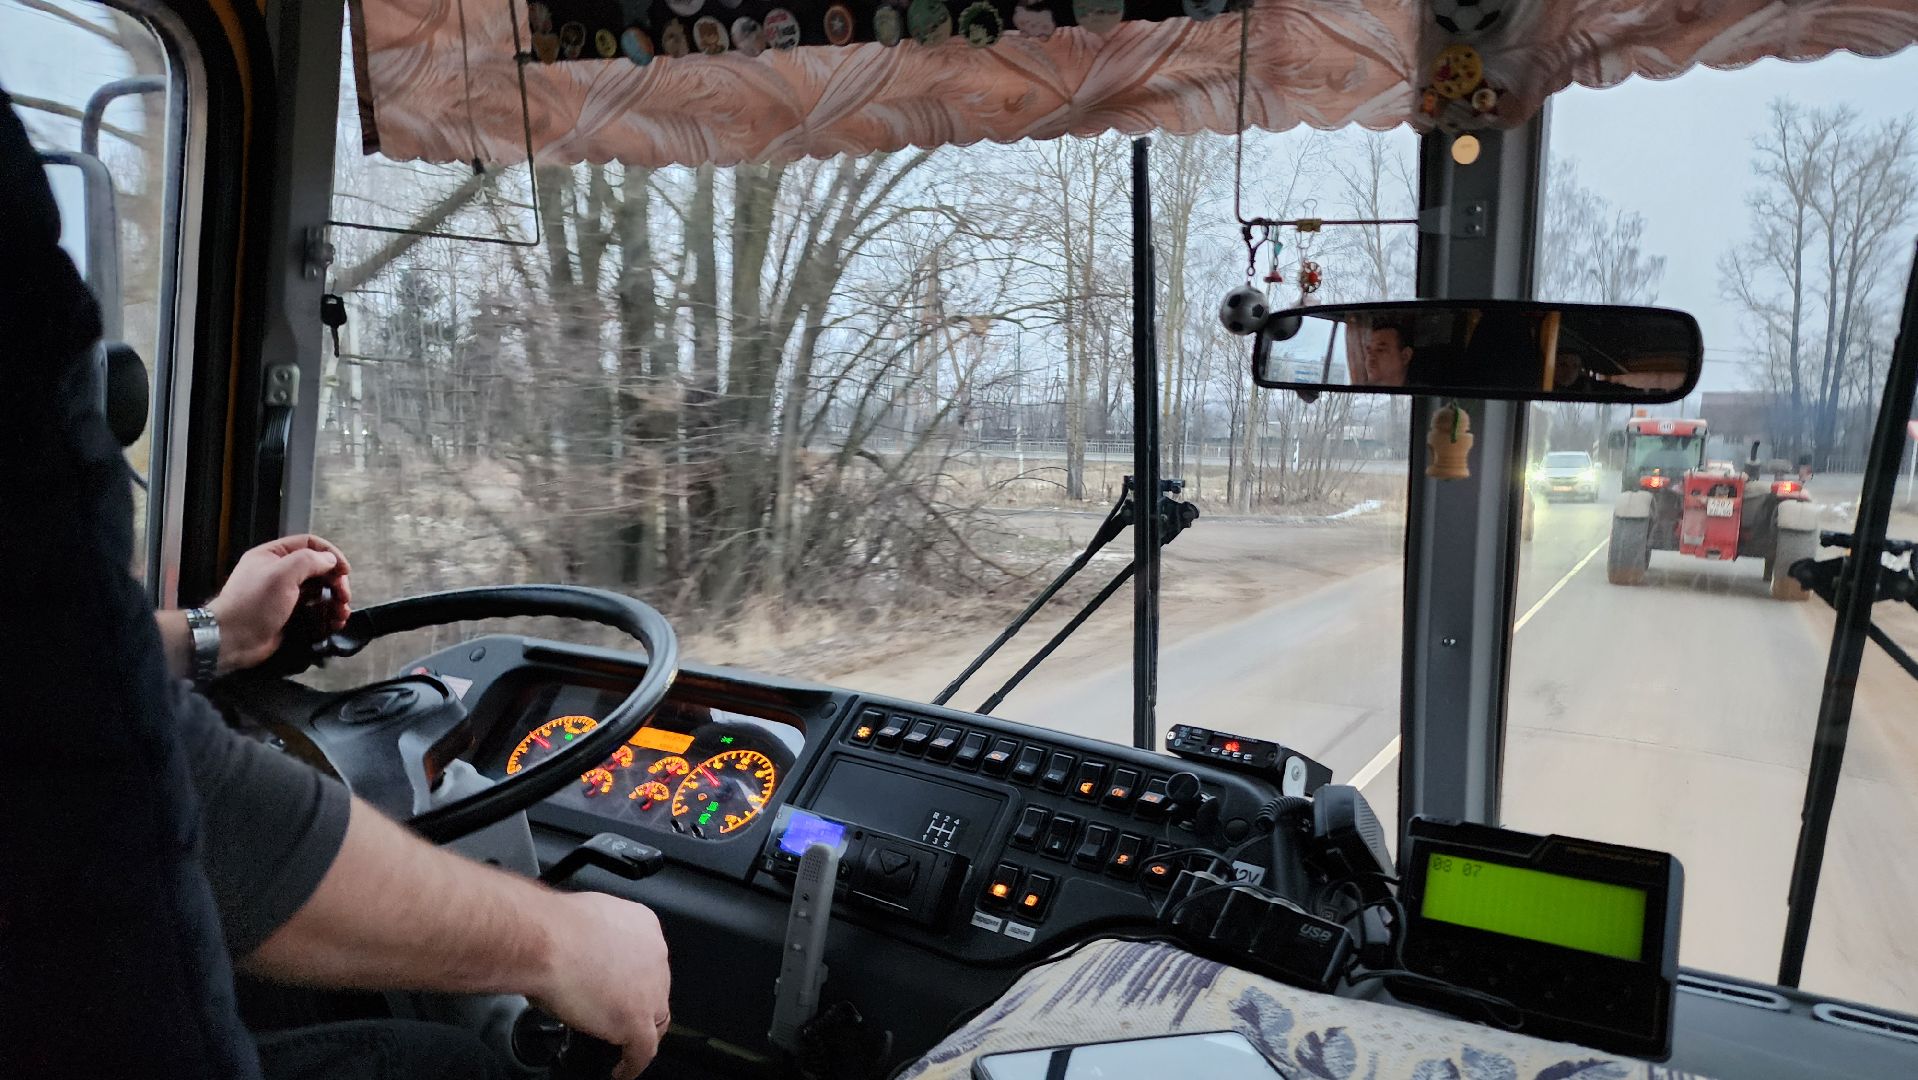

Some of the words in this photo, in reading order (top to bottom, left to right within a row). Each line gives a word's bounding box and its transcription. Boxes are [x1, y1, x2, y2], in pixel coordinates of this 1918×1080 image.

[932, 811, 940, 819] R
[1235, 867, 1260, 884] 2V
[1300, 923, 1332, 941] USB
